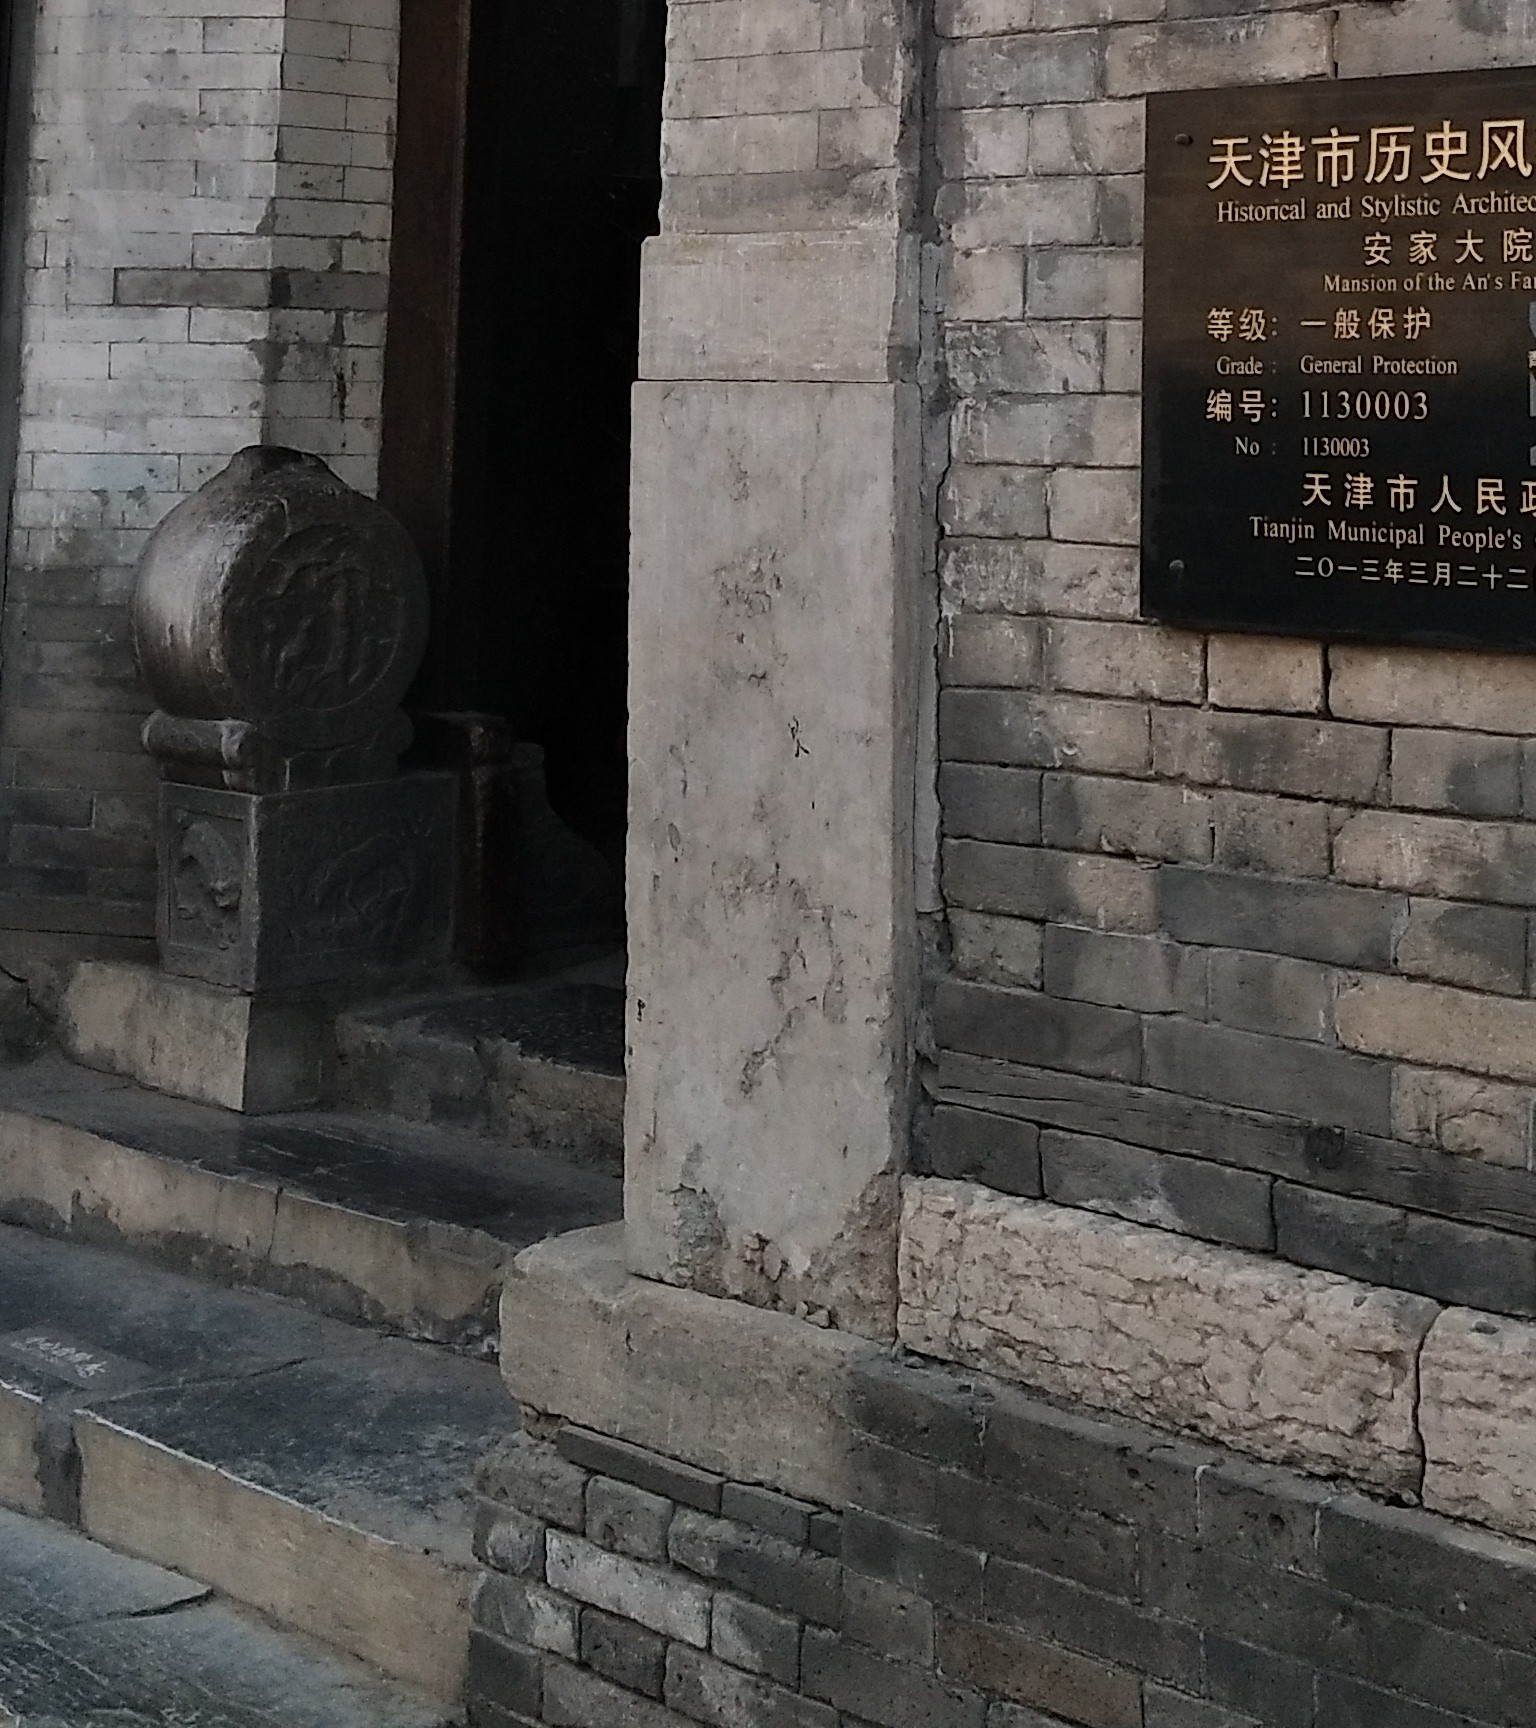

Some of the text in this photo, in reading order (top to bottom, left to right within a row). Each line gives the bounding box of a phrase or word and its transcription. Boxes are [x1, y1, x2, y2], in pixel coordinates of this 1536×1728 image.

[1217, 198, 1306, 222] Historical
[1316, 196, 1351, 219] and
[1361, 193, 1441, 222] Stylistic
[1364, 228, 1534, 266] 安家大院
[1324, 273, 1397, 293] Mansion
[1403, 272, 1425, 290] of
[1428, 272, 1455, 291] the
[1300, 305, 1432, 340] 一般保护
[1300, 355, 1362, 374] General
[1373, 355, 1457, 375] Protection
[1302, 390, 1428, 420] 1130003
[1303, 437, 1370, 458] 1130003
[1249, 516, 1314, 544] Tianjin
[1327, 520, 1424, 549] Municipal
[1439, 524, 1522, 553] People's
